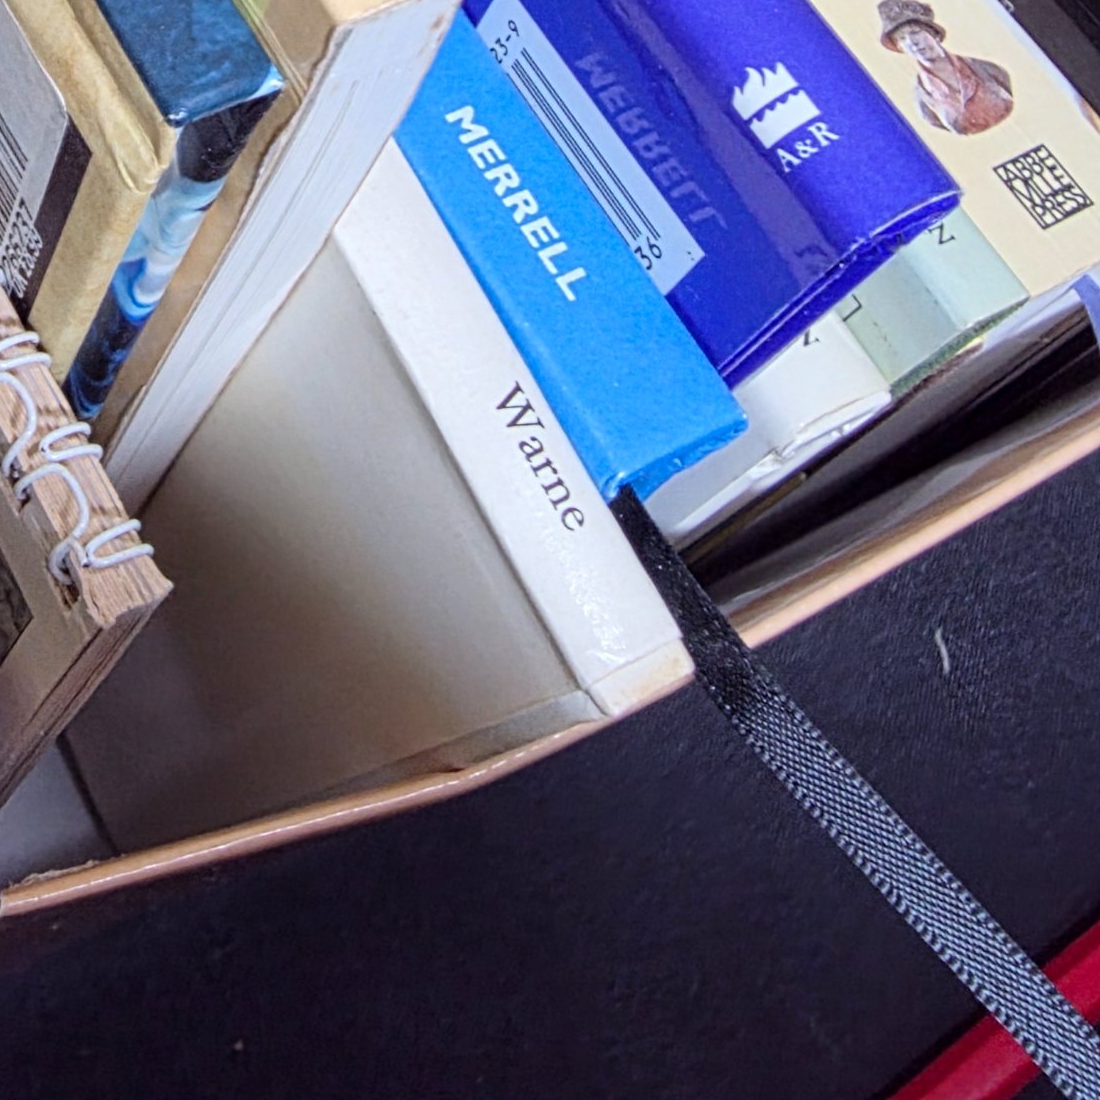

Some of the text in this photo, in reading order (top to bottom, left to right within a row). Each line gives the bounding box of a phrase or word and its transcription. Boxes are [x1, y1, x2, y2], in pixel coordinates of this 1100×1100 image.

[445, 105, 587, 302] MERRELL
[775, 120, 840, 173] A&R
[496, 381, 588, 532] Warne
